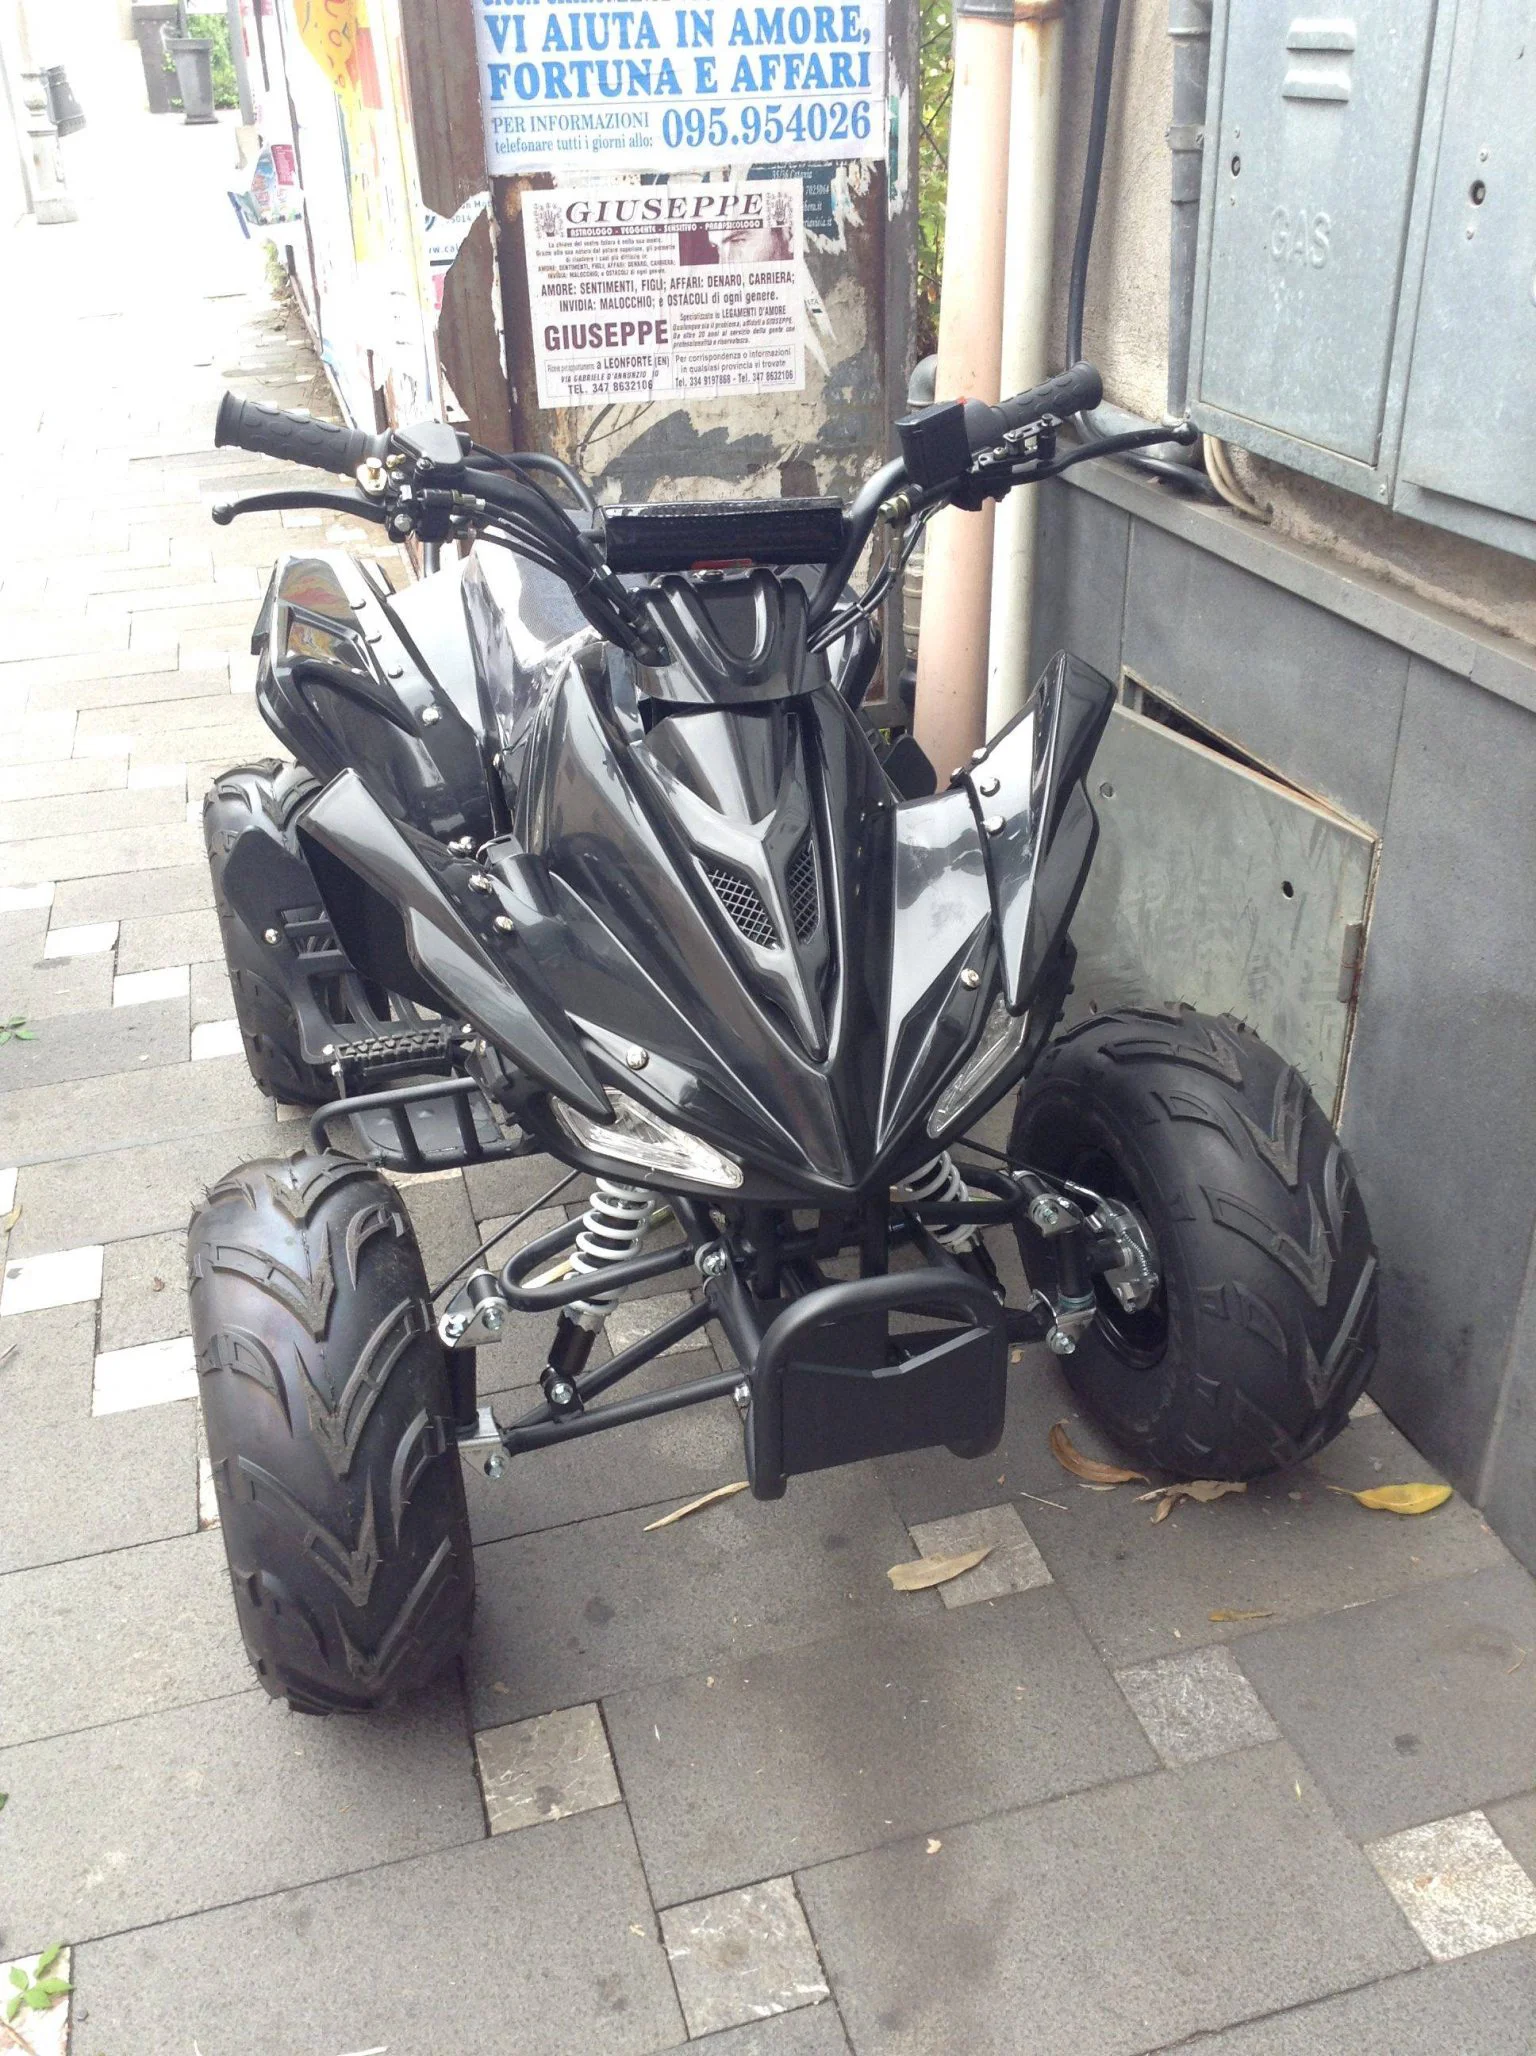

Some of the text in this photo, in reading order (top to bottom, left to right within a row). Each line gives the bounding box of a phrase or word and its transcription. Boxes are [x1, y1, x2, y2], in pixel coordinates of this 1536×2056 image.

[484, 5, 871, 54] VI AIUTA IN AMORE,
[487, 51, 871, 101] FORTUNA E AFFARI
[492, 111, 650, 134] PER INFORMAZIONI
[662, 100, 871, 148] 095.954026
[494, 129, 653, 154] telefonare tutti i giorni allo:
[565, 192, 763, 225] GIUSEPPE
[570, 227, 613, 237] ASTROLOGO
[663, 223, 697, 232] SENSITIVO
[705, 220, 760, 230] PARAPSICOLOGO
[1270, 205, 1331, 270] GAS
[541, 271, 795, 296] AMORE: SENTIMENTI, FIGLI; AFFARI: DENARO, CARRIERA;
[559, 299, 596, 312] INVIDIA:
[600, 296, 655, 310] MALOCCHIO;
[667, 292, 708, 306] OSTACOLI
[711, 291, 720, 304] di
[723, 290, 742, 305] ogni
[745, 290, 779, 304] genere.
[721, 306, 757, 319] LEGAMENTI
[759, 305, 786, 316] D'AMORE
[544, 319, 669, 351] GIUSEPPE
[604, 355, 653, 370] LEONFORTE
[654, 356, 670, 368] (EN)
[675, 354, 687, 363] Per
[688, 352, 741, 364] corrispondenza
[749, 348, 791, 358] informazioni
[680, 365, 688, 373] in
[689, 363, 720, 374] qualsiasi
[721, 361, 753, 372] provincia
[762, 359, 786, 368] trovate
[568, 380, 653, 395] TEL. 347 8632106
[573, 373, 605, 382] GABRIELE
[675, 377, 687, 387] Tel.
[689, 375, 701, 386] 334
[738, 372, 750, 383] Tel.
